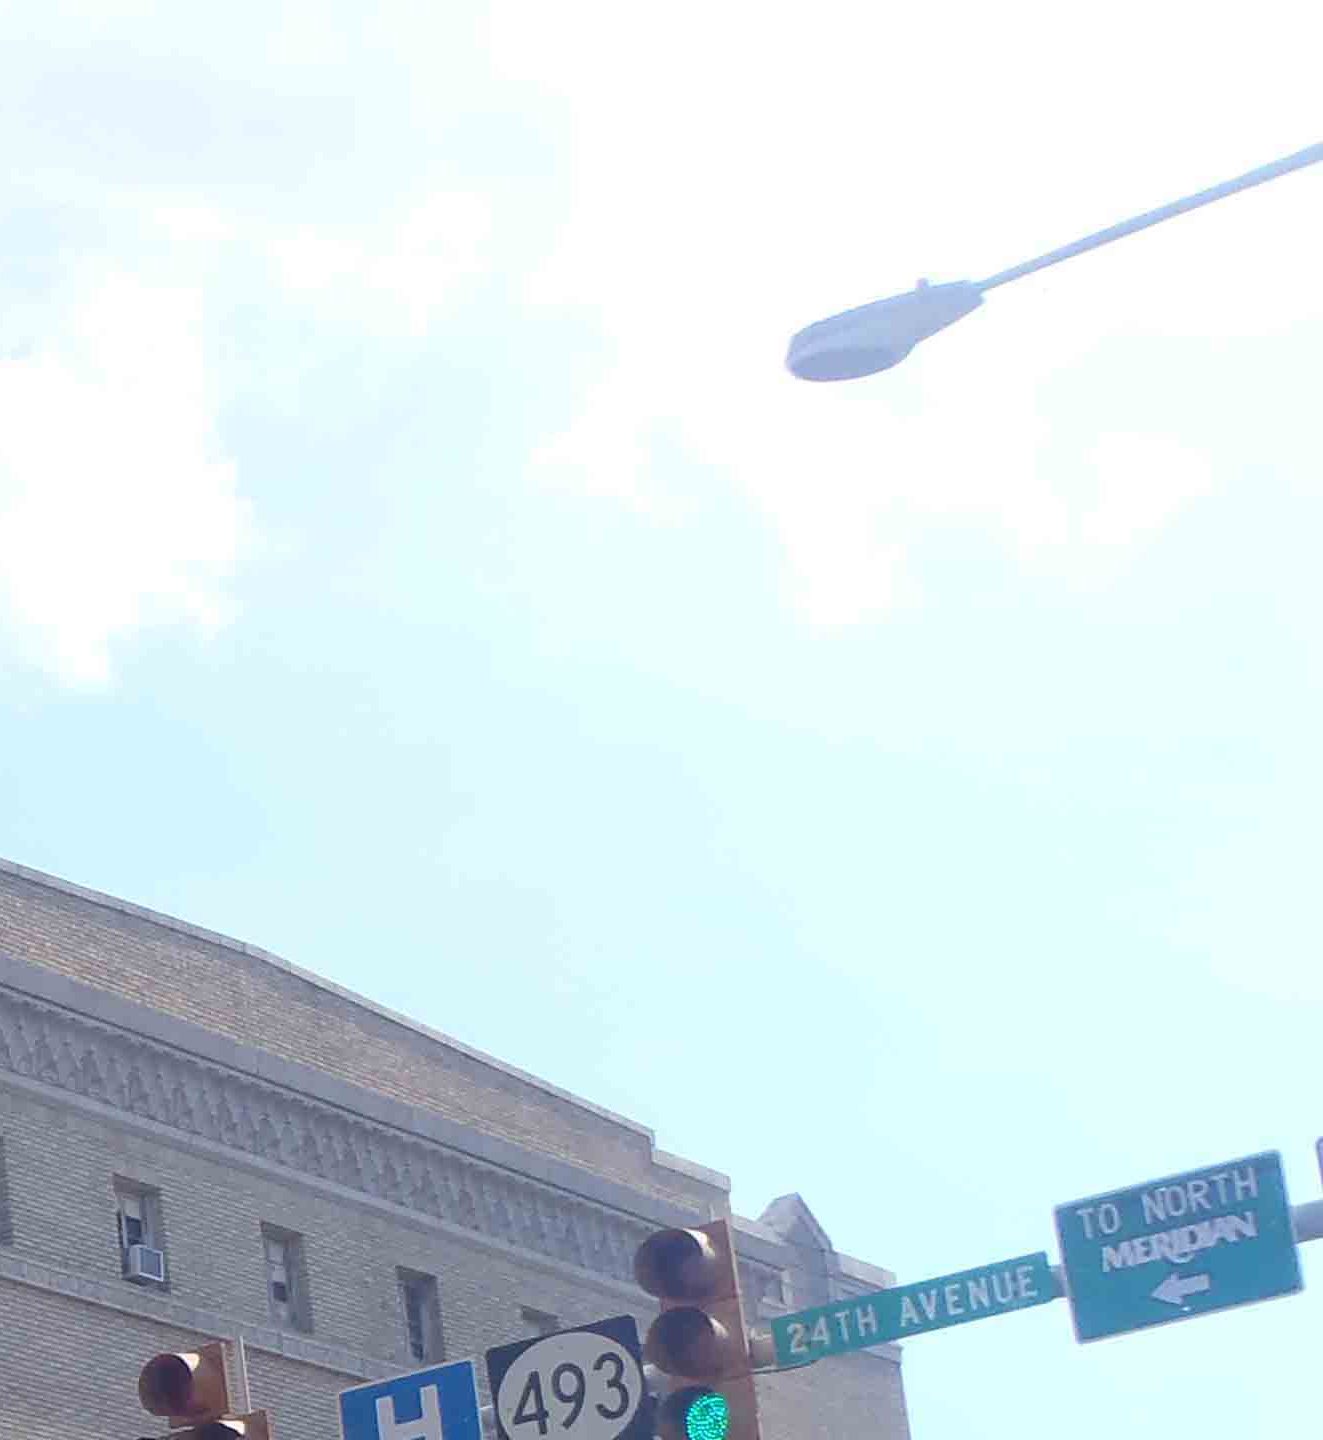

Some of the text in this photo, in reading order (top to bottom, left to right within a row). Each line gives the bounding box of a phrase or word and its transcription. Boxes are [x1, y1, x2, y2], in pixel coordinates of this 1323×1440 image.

[1076, 1167, 1258, 1241] TO NORTH
[1101, 1211, 1259, 1272] MERIDIAN
[785, 1265, 1040, 1355] 24TH AVENUE
[512, 1351, 631, 1436] 493
